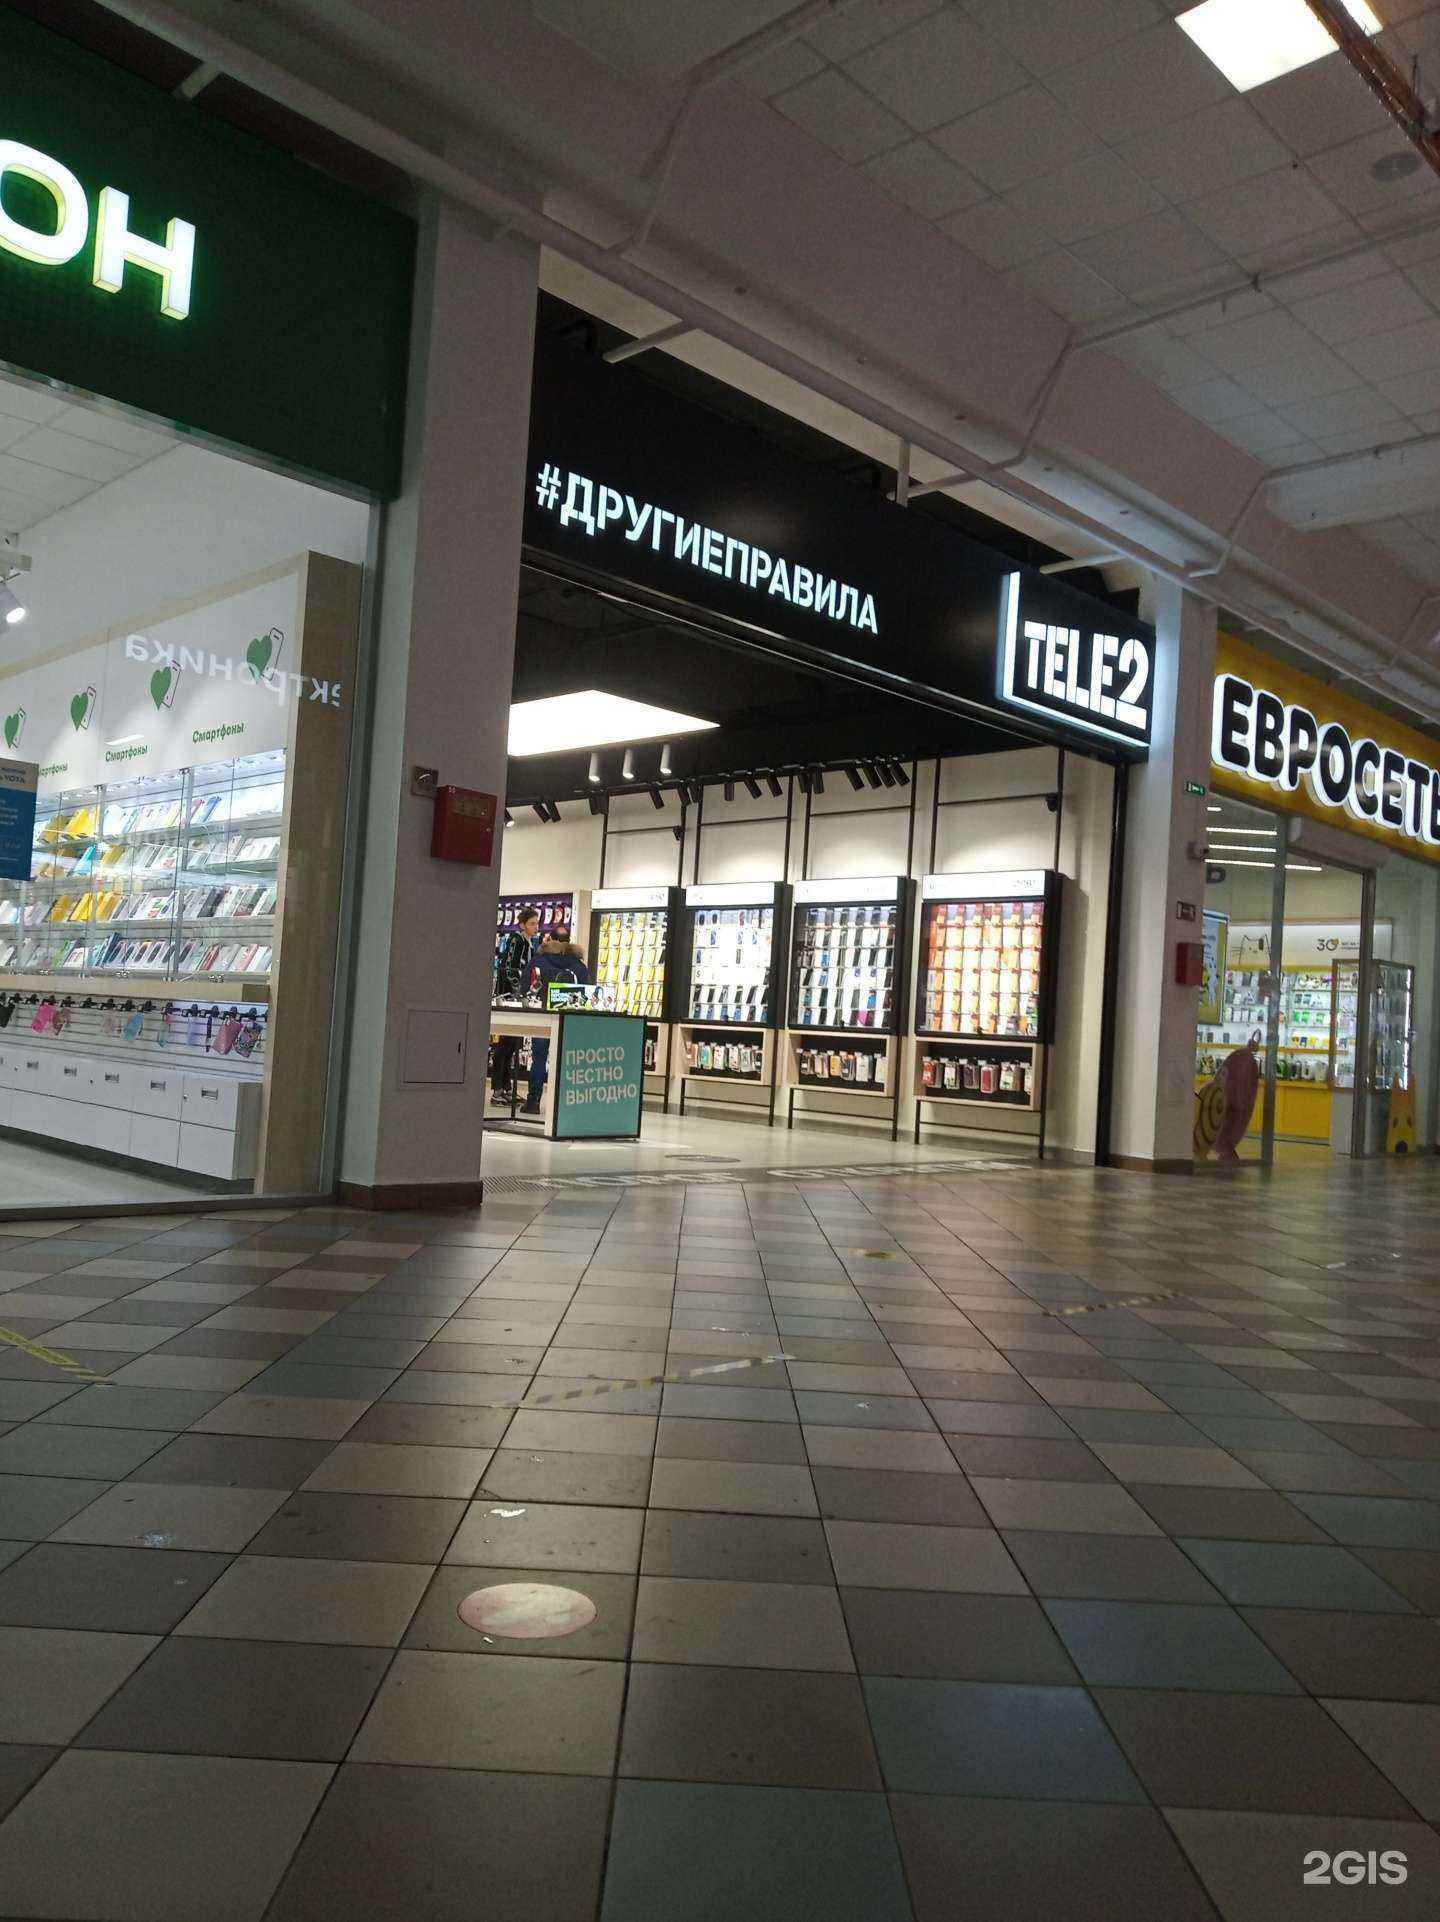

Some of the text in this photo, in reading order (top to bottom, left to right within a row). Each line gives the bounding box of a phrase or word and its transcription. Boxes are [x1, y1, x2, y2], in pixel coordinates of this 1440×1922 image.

[535, 462, 879, 635] #ДРУГИЕПРАВИЛА
[1023, 619, 1149, 730] TELE2
[192, 722, 245, 743] Смартфоны
[105, 745, 148, 762] Смартфоны
[39, 764, 68, 778] артфоны
[565, 1046, 625, 1065] ПРОСТО
[565, 1066, 624, 1085] ЧЕСТНО
[565, 1083, 637, 1106] ВЫГОДНО
